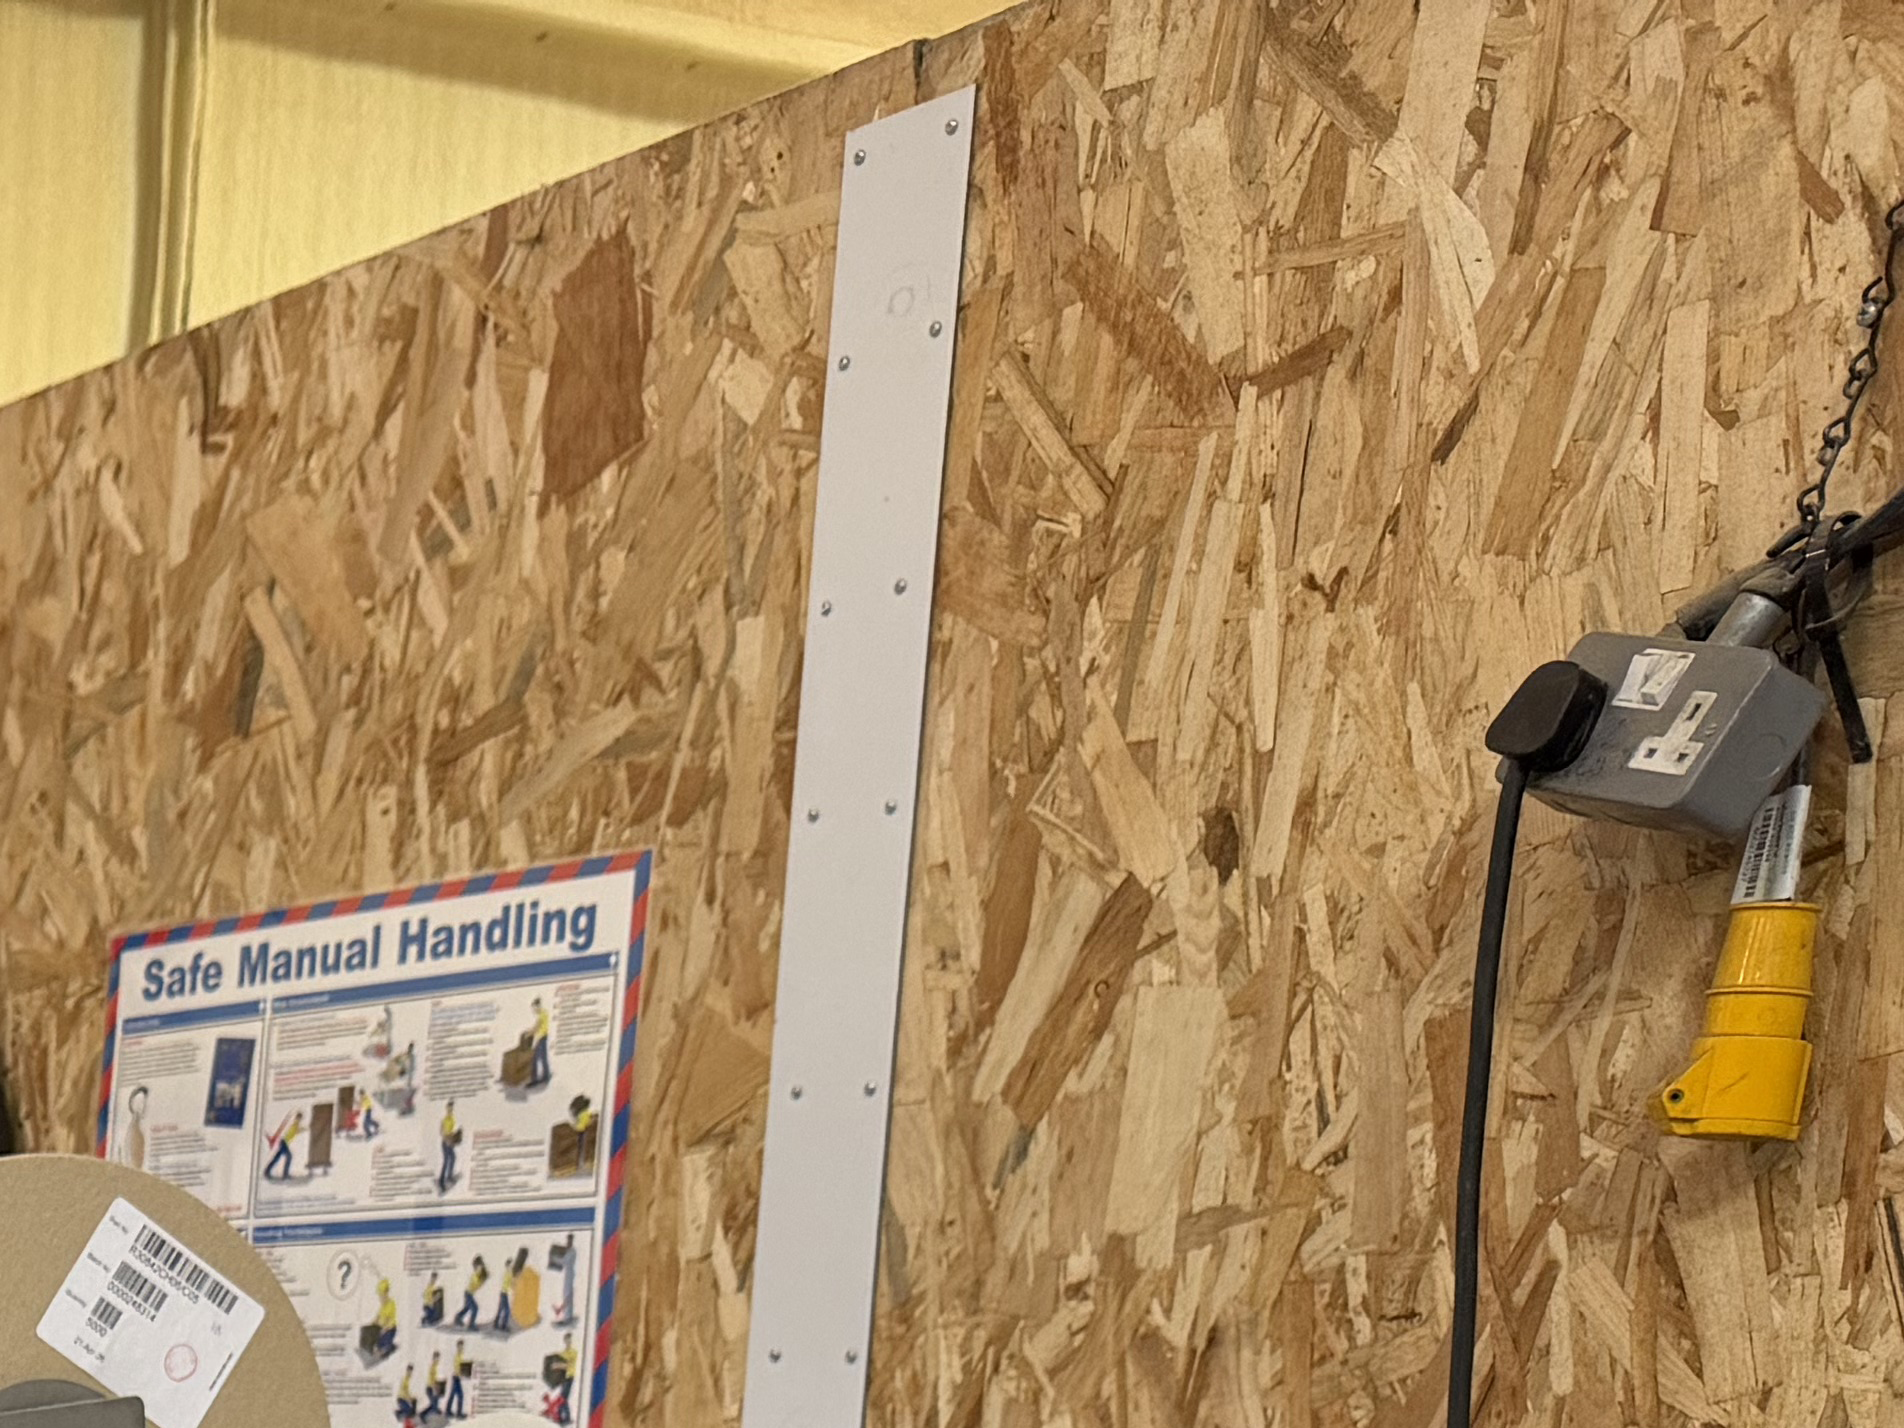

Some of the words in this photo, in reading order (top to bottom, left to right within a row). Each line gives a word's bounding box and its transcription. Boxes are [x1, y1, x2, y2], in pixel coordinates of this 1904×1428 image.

[143, 957, 223, 1001] Safe
[239, 927, 381, 988] Manual
[398, 899, 597, 965] Handling
